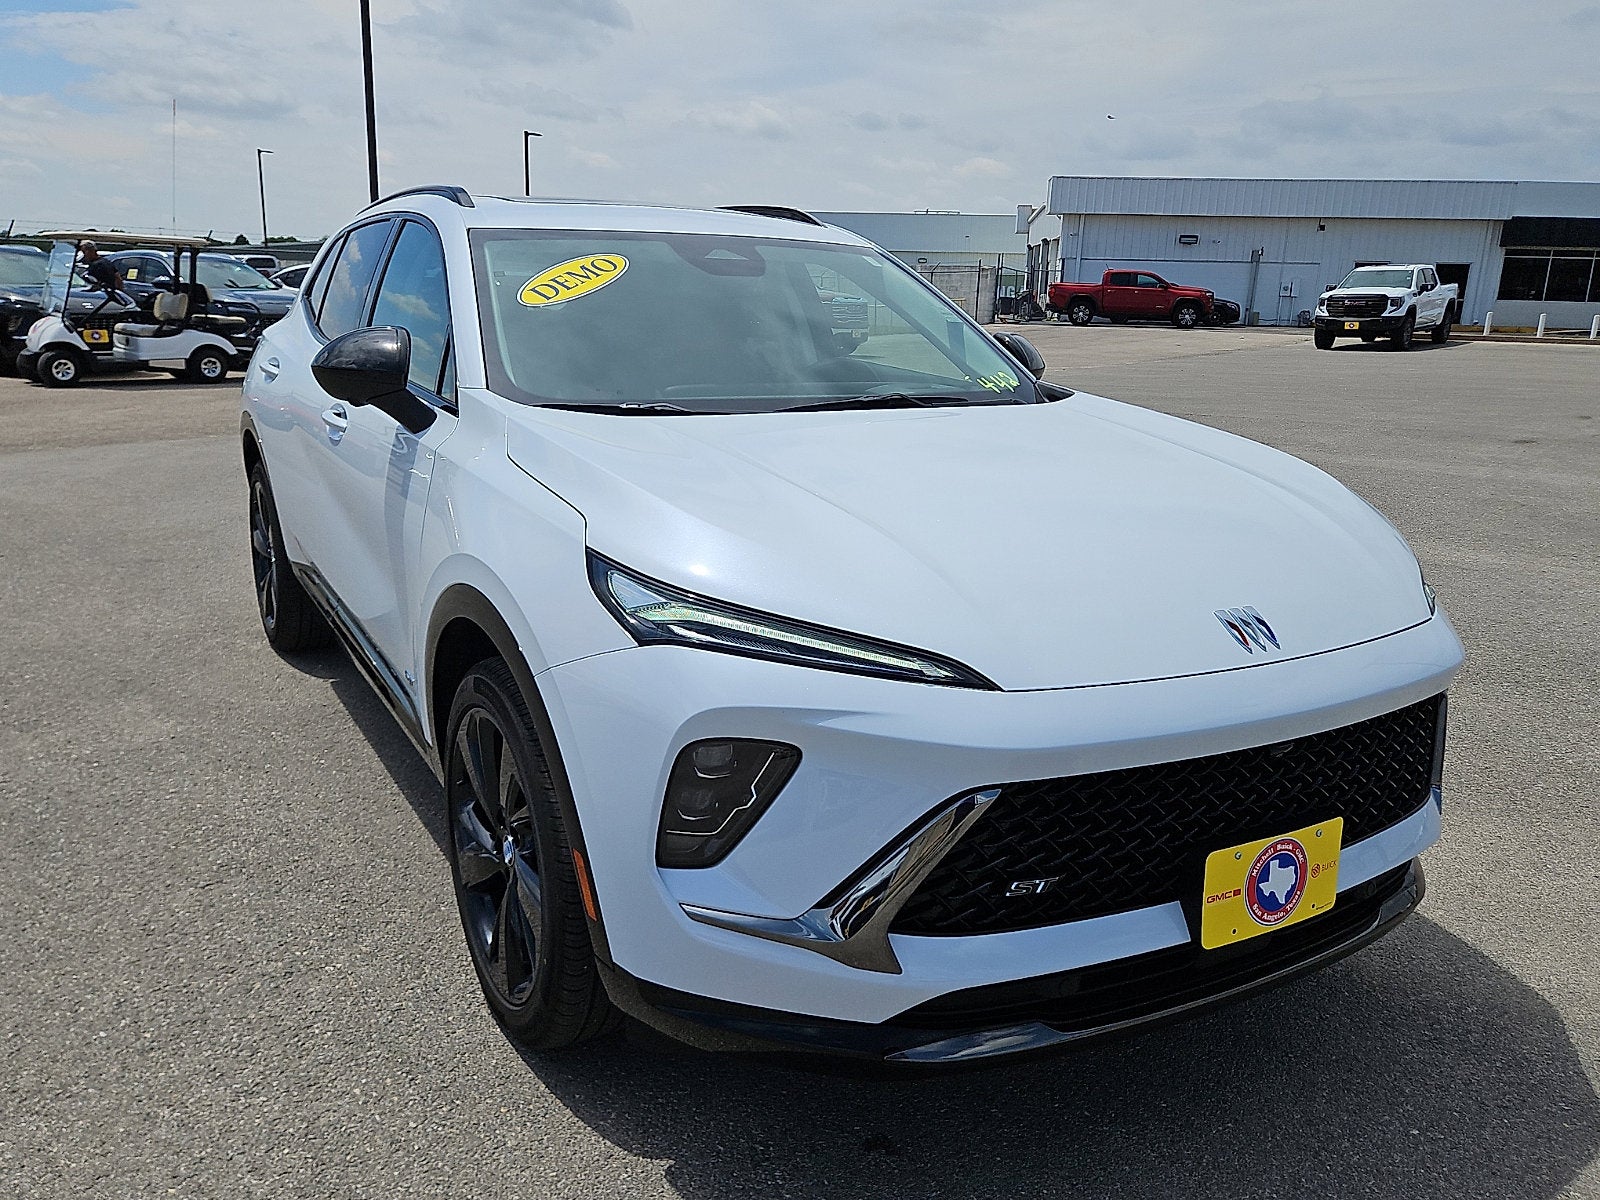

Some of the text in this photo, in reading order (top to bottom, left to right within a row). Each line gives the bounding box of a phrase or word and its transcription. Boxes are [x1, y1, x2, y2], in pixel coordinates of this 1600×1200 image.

[526, 258, 618, 301] DEMO
[1251, 847, 1274, 877] Mitchell
[1321, 859, 1337, 872] BUICK
[1005, 873, 1060, 897] ST
[1206, 890, 1232, 904] GMC
[1252, 903, 1262, 917] San
[1286, 890, 1301, 911] Texas
